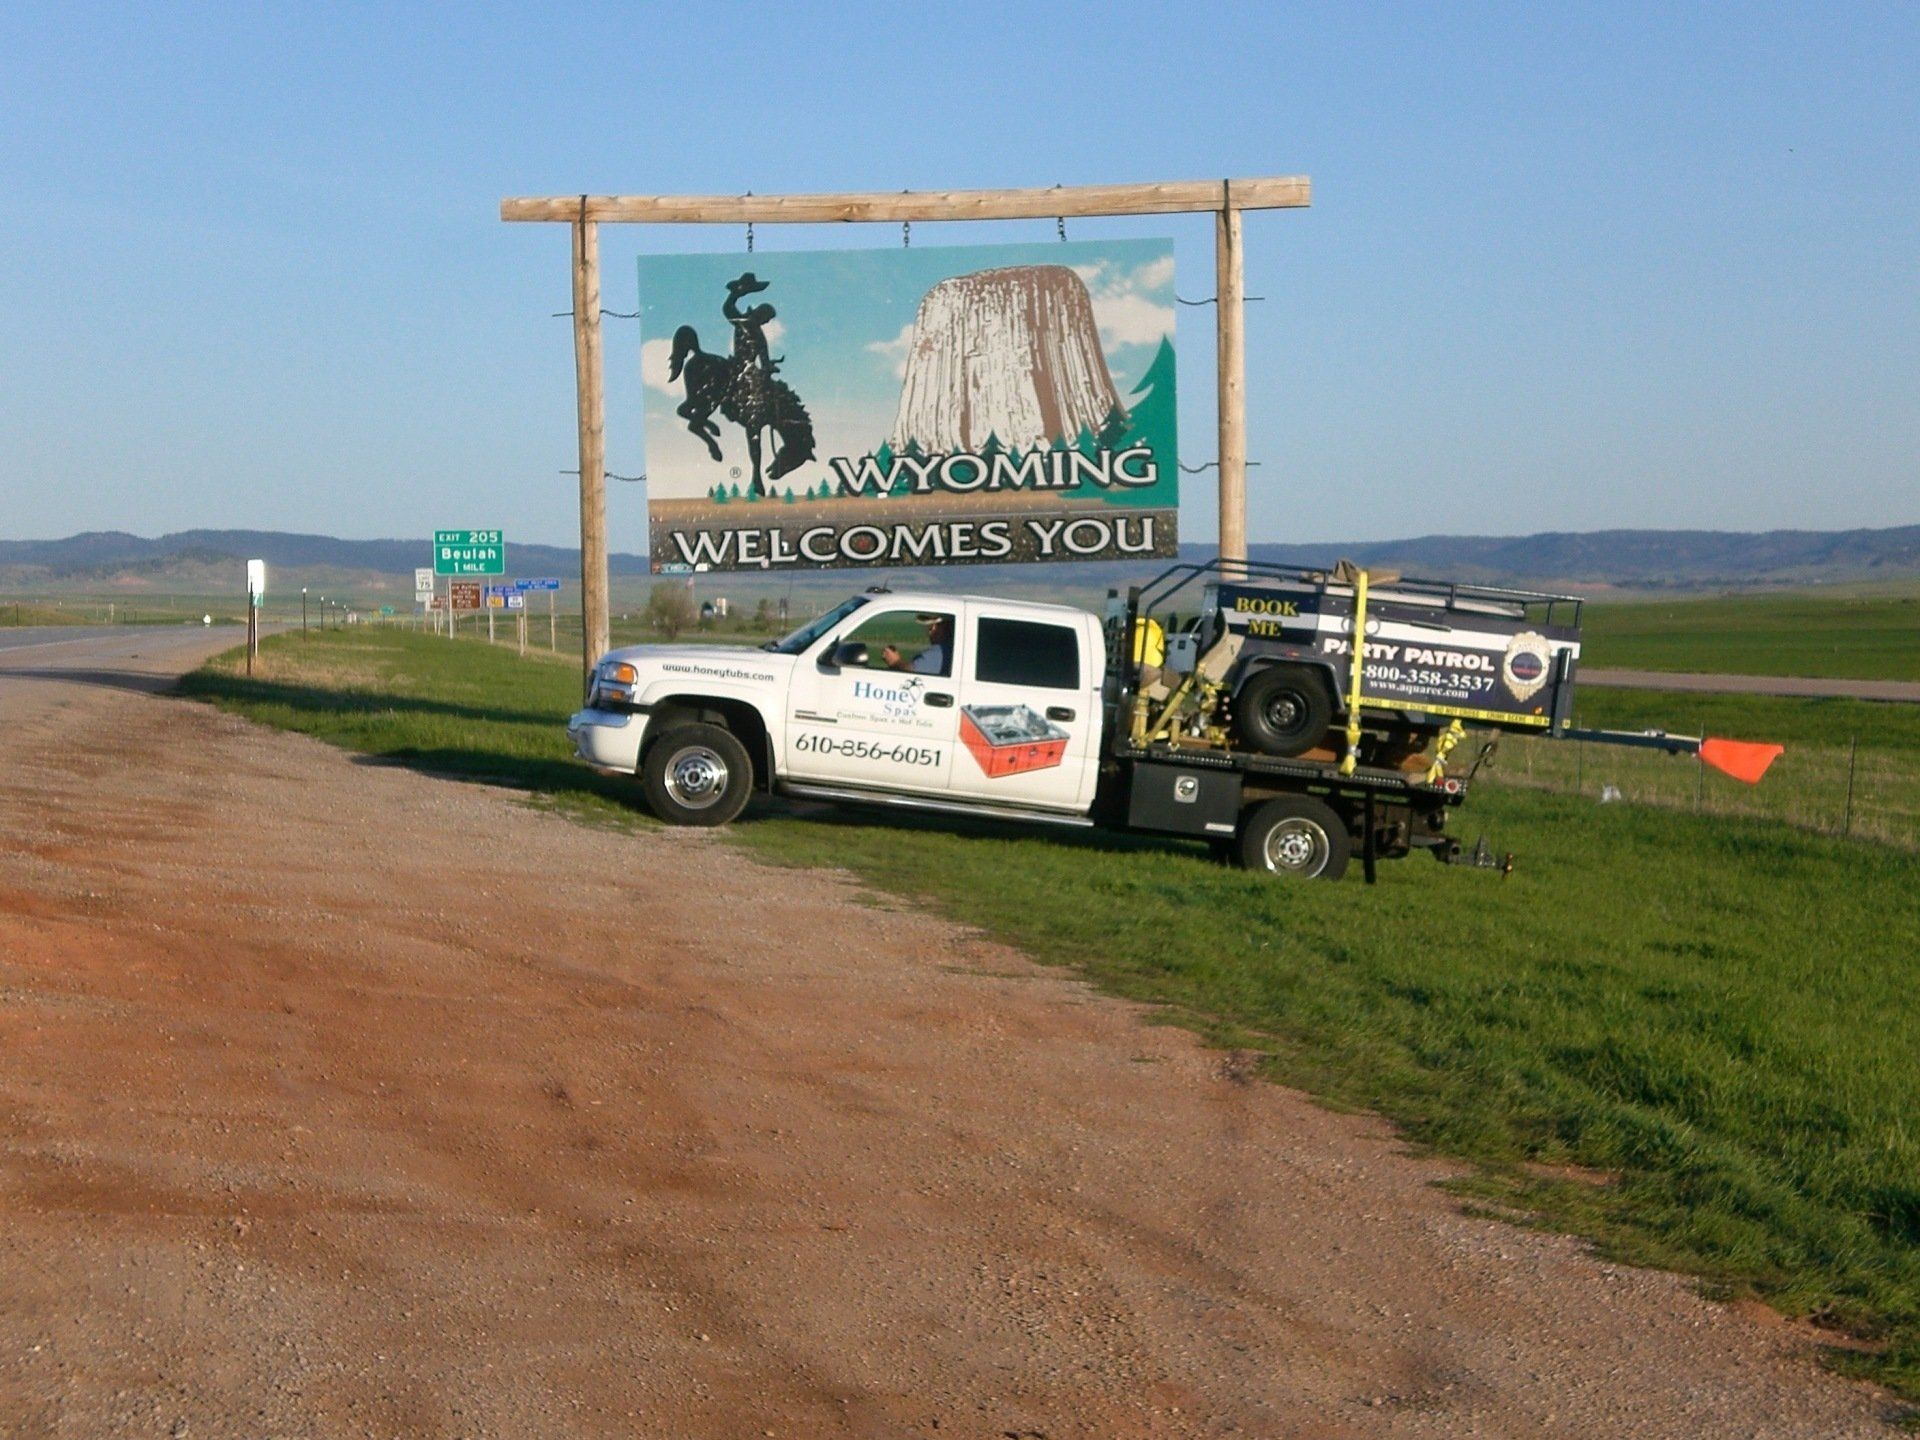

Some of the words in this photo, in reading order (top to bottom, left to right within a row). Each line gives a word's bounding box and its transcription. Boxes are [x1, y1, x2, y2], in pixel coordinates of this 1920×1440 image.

[834, 446, 1159, 494] WYOMING
[439, 533, 459, 541] EXIT
[469, 531, 498, 543] 205
[672, 520, 1012, 566] WELCOMES
[1027, 517, 1157, 556] YOU
[441, 547, 496, 560] Beulah
[454, 562, 458, 573] 1
[463, 563, 485, 572] MILE
[1235, 596, 1299, 617] BOOK
[1248, 619, 1282, 637] ME
[1404, 647, 1495, 672] PATROL
[662, 663, 774, 681] www.honeytubs.com
[853, 680, 924, 708] Honey
[884, 703, 916, 717] Spas
[795, 733, 941, 767] 610-856-6051
